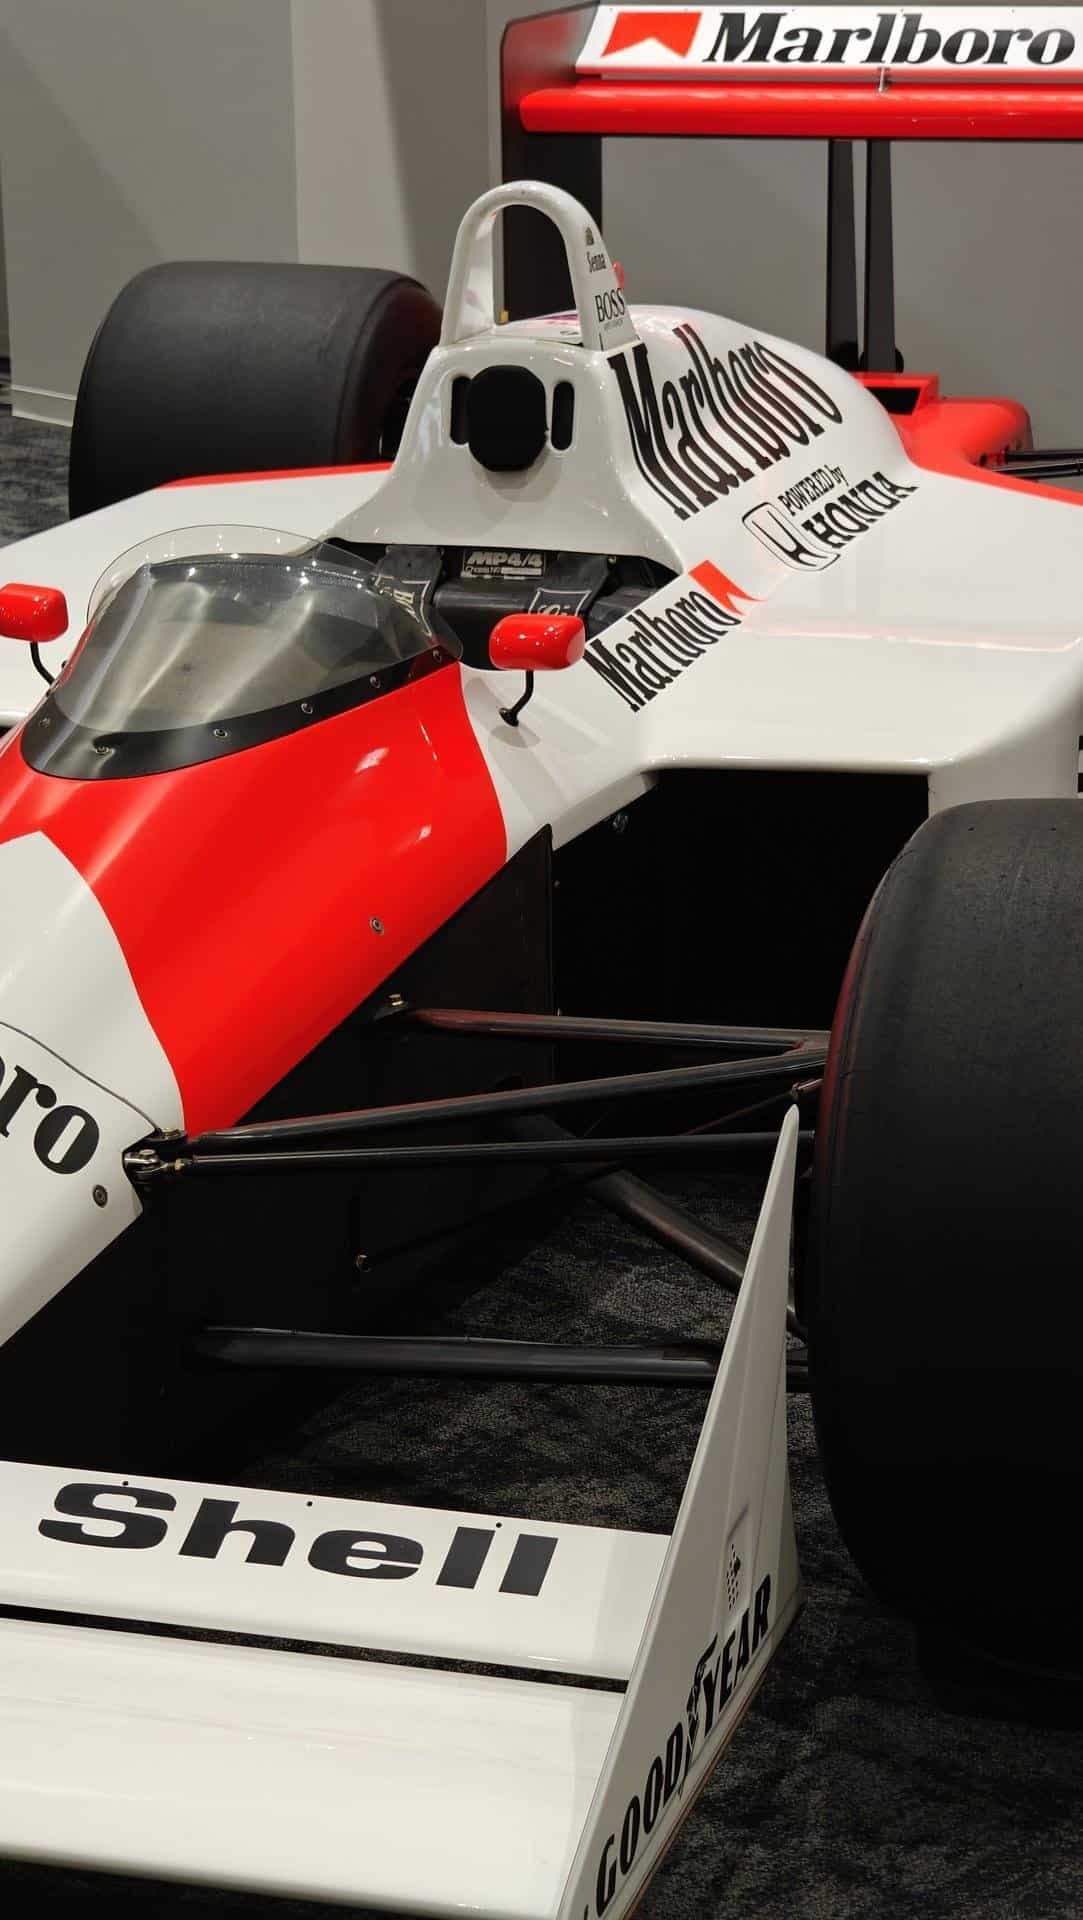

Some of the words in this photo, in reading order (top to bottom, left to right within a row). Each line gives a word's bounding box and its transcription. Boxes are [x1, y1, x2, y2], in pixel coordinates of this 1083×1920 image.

[702, 12, 1076, 65] Marlboro
[586, 251, 607, 273] Senna
[595, 287, 625, 322] BOSS
[607, 323, 843, 521] Marlboro
[777, 468, 835, 517] POWERED
[824, 464, 849, 487] by
[801, 471, 919, 549] HONDA
[466, 551, 543, 567] MP4/4
[582, 591, 742, 712] Marlboro
[0, 1055, 99, 1175] ro
[38, 1482, 558, 1597] Shell
[596, 1574, 770, 1918] GOODYEAR
